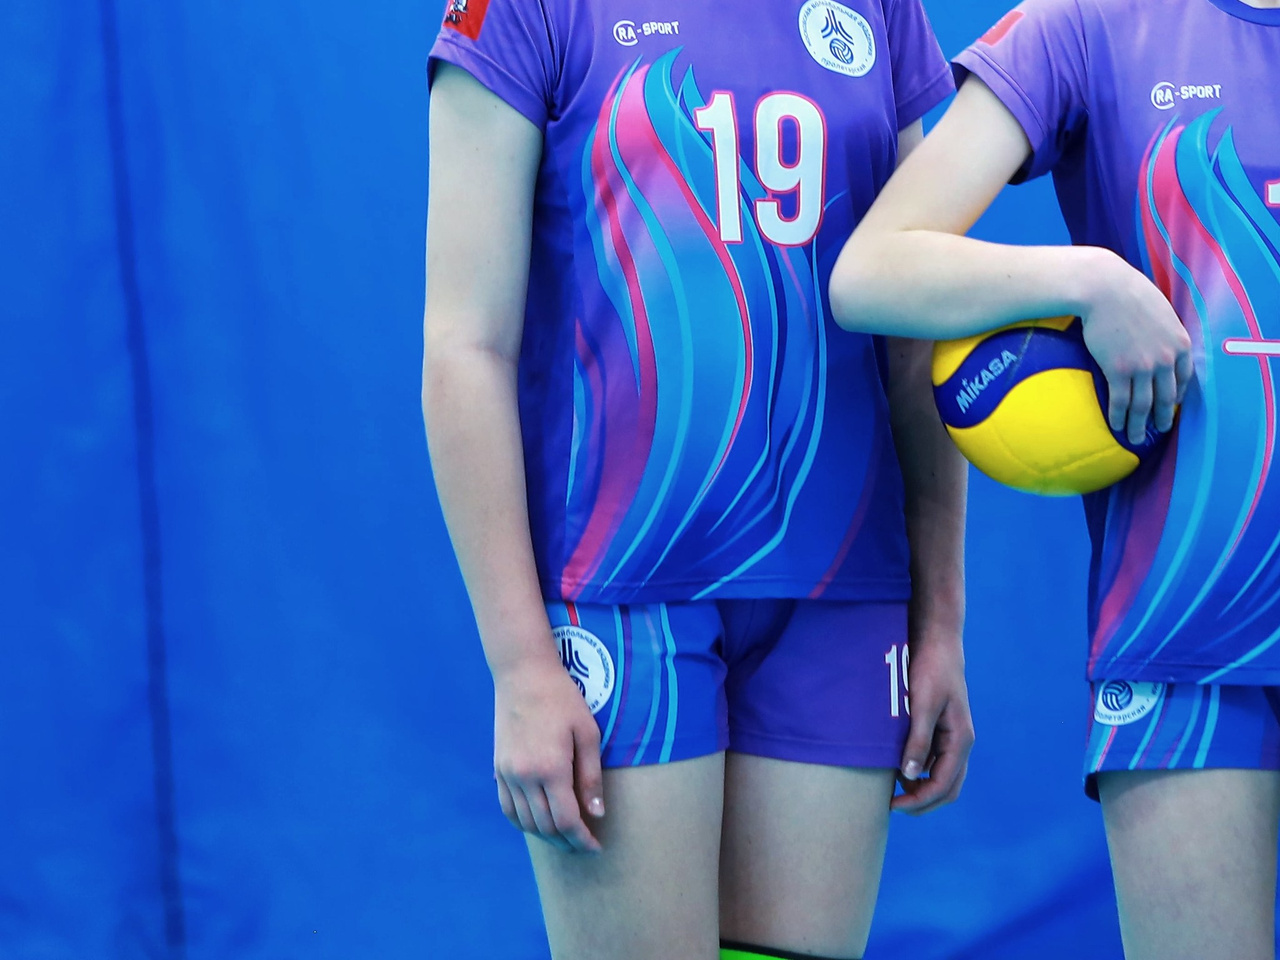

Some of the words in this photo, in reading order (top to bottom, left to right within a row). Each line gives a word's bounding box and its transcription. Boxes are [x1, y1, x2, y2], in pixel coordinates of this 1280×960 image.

[616, 21, 680, 43] RA-SPORT
[1153, 83, 1222, 106] RA-SPORT
[694, 91, 827, 247] 19
